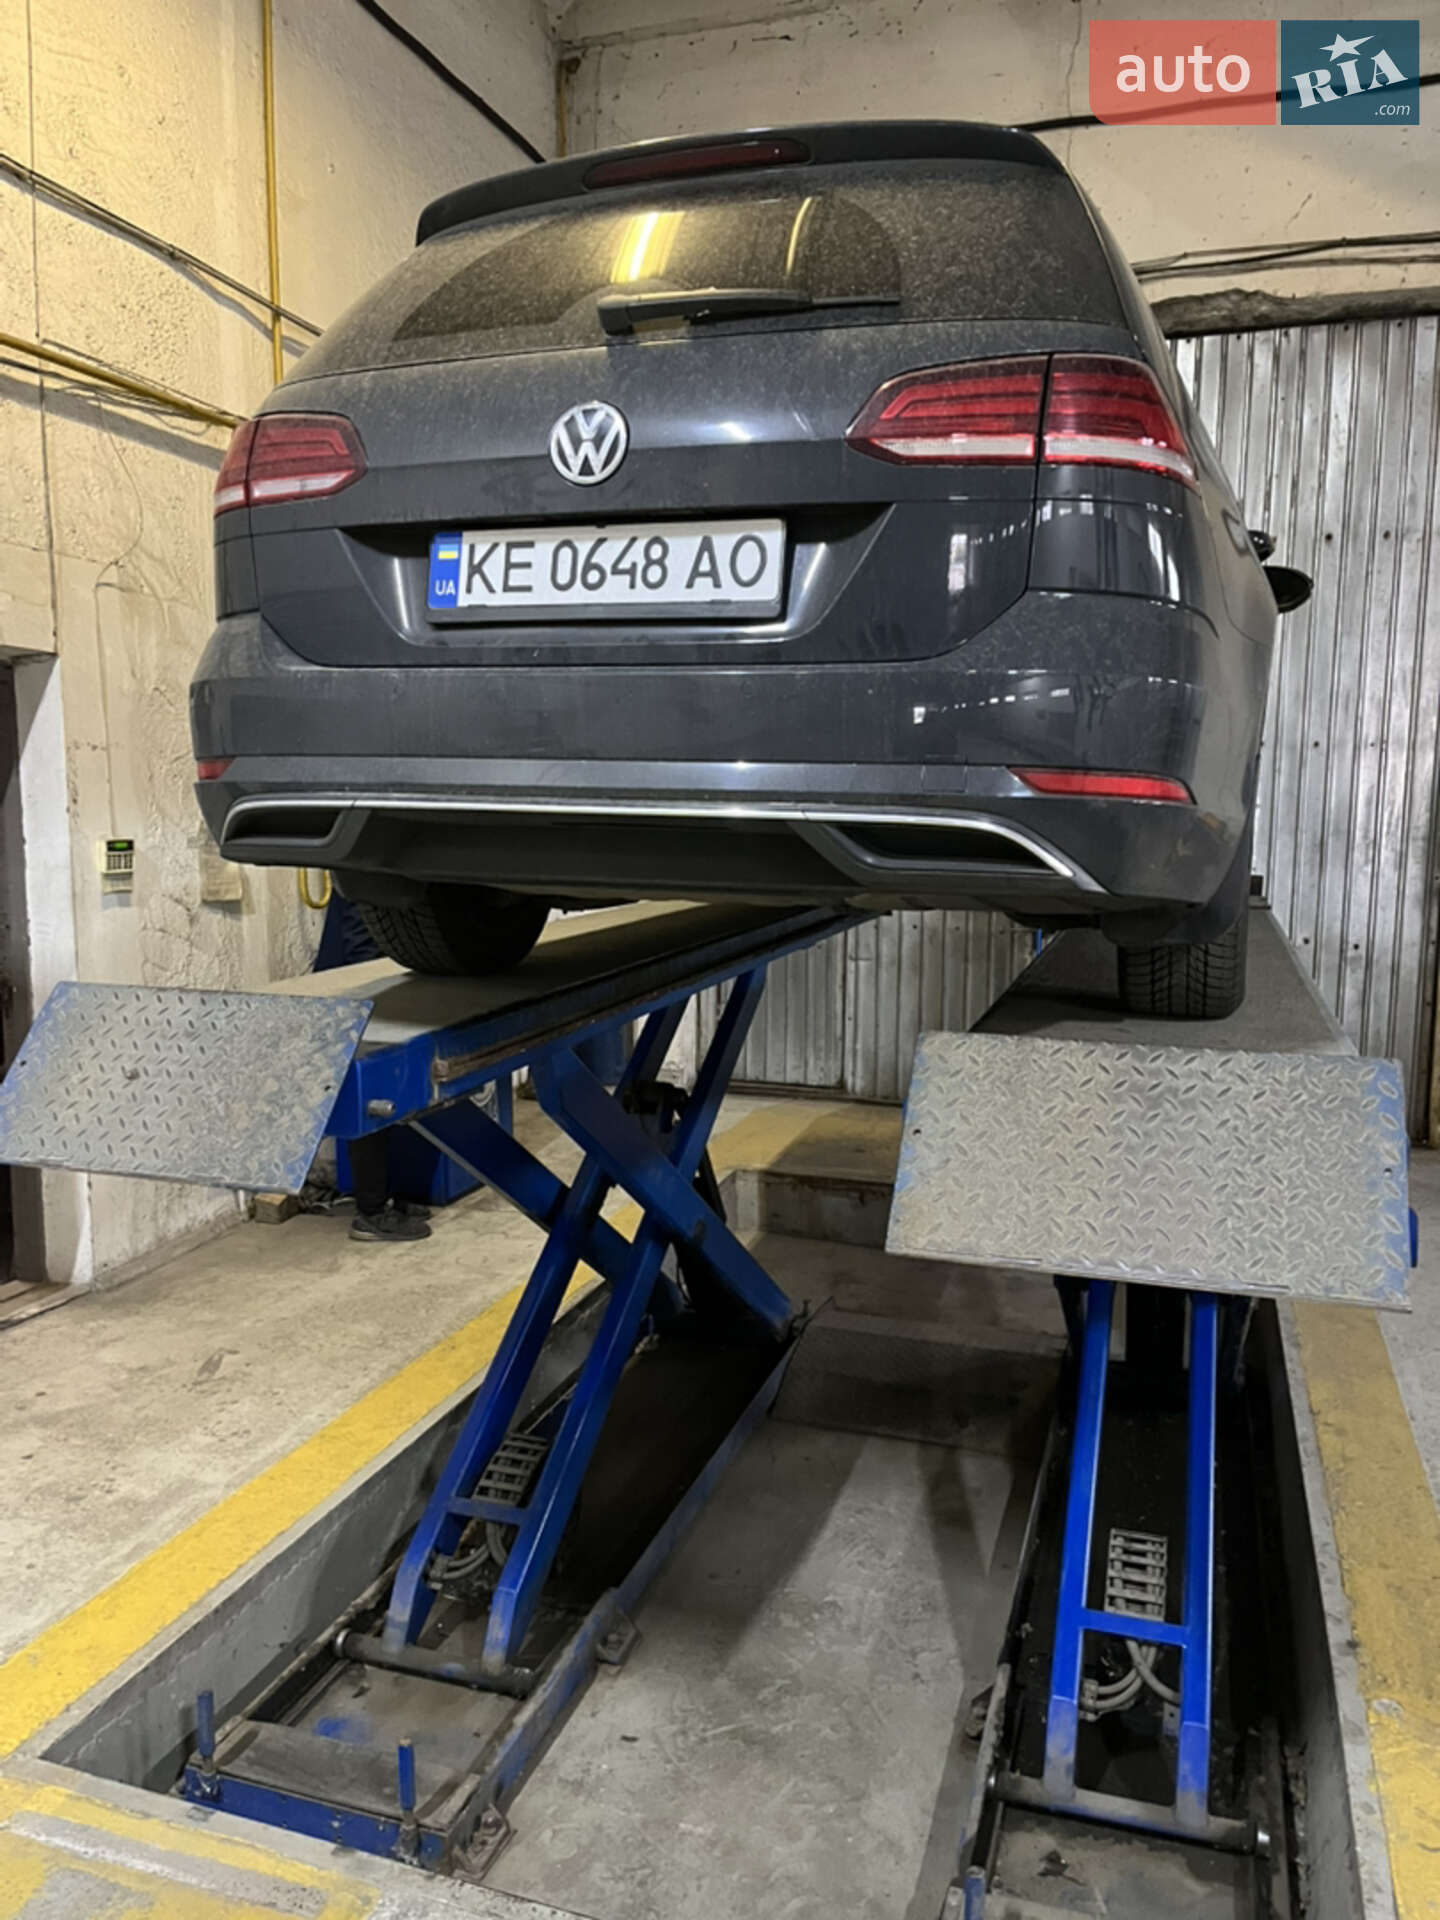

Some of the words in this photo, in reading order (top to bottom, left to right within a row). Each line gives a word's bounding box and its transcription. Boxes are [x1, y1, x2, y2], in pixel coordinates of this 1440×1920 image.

[552, 402, 626, 483] VW
[435, 579, 456, 596] UA
[464, 540, 535, 594] KE
[550, 535, 669, 591] 0648
[685, 534, 767, 590] AO
